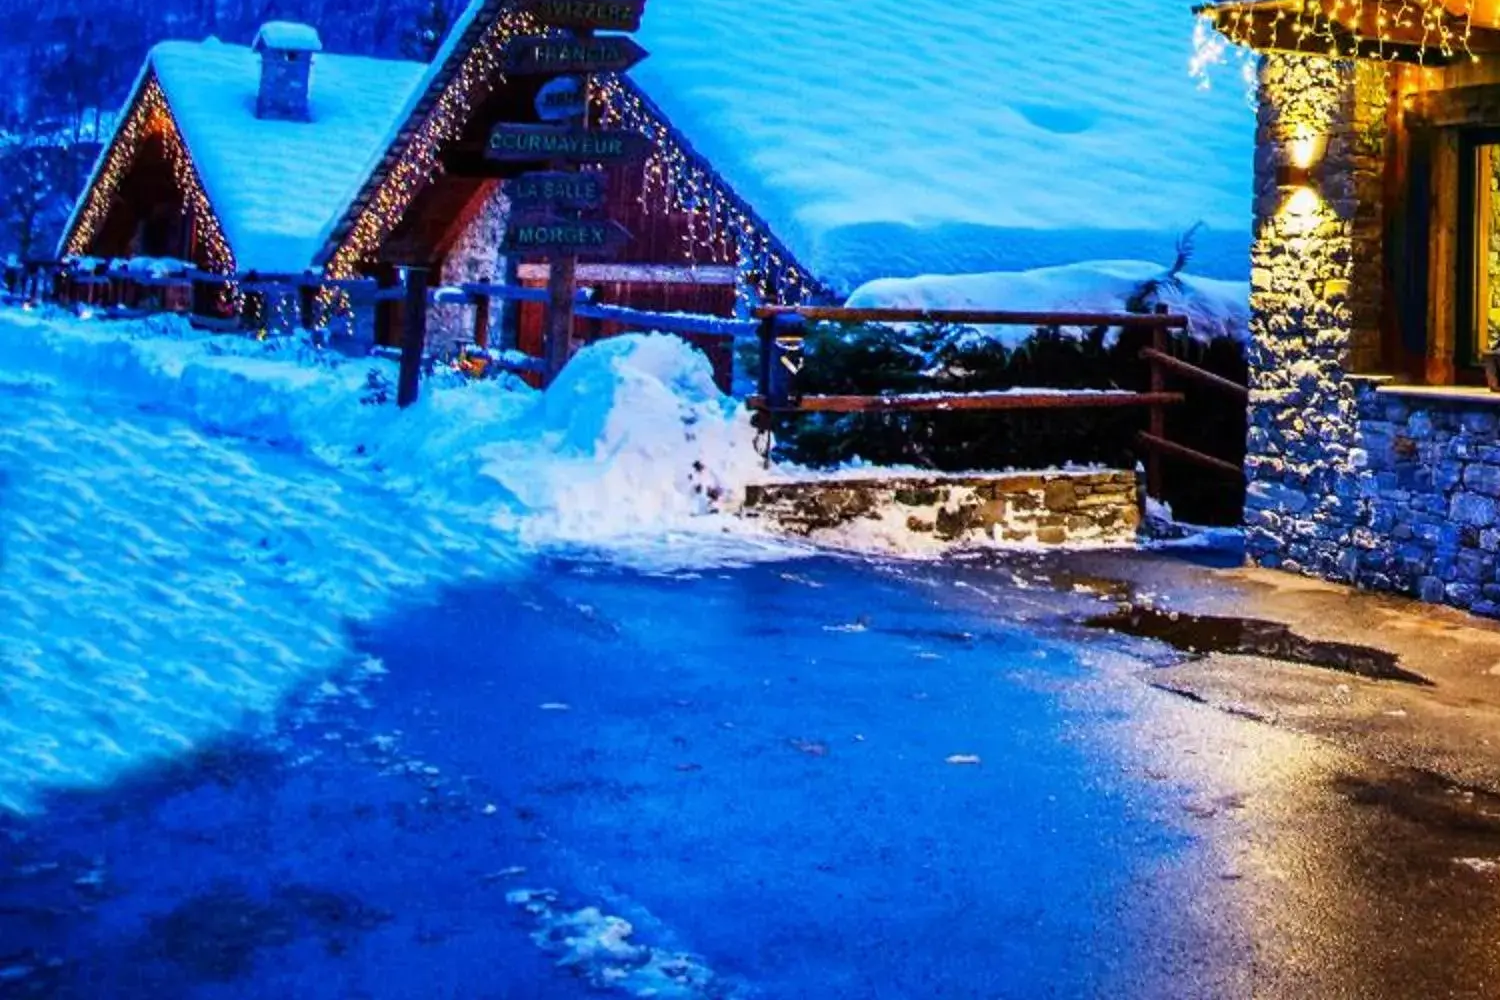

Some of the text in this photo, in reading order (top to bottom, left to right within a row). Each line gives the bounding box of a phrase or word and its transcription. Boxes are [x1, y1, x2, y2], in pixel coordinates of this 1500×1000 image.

[489, 131, 624, 156] COURMAYEUR
[516, 181, 597, 200] LA SALLE
[518, 226, 605, 246] MORGEX
